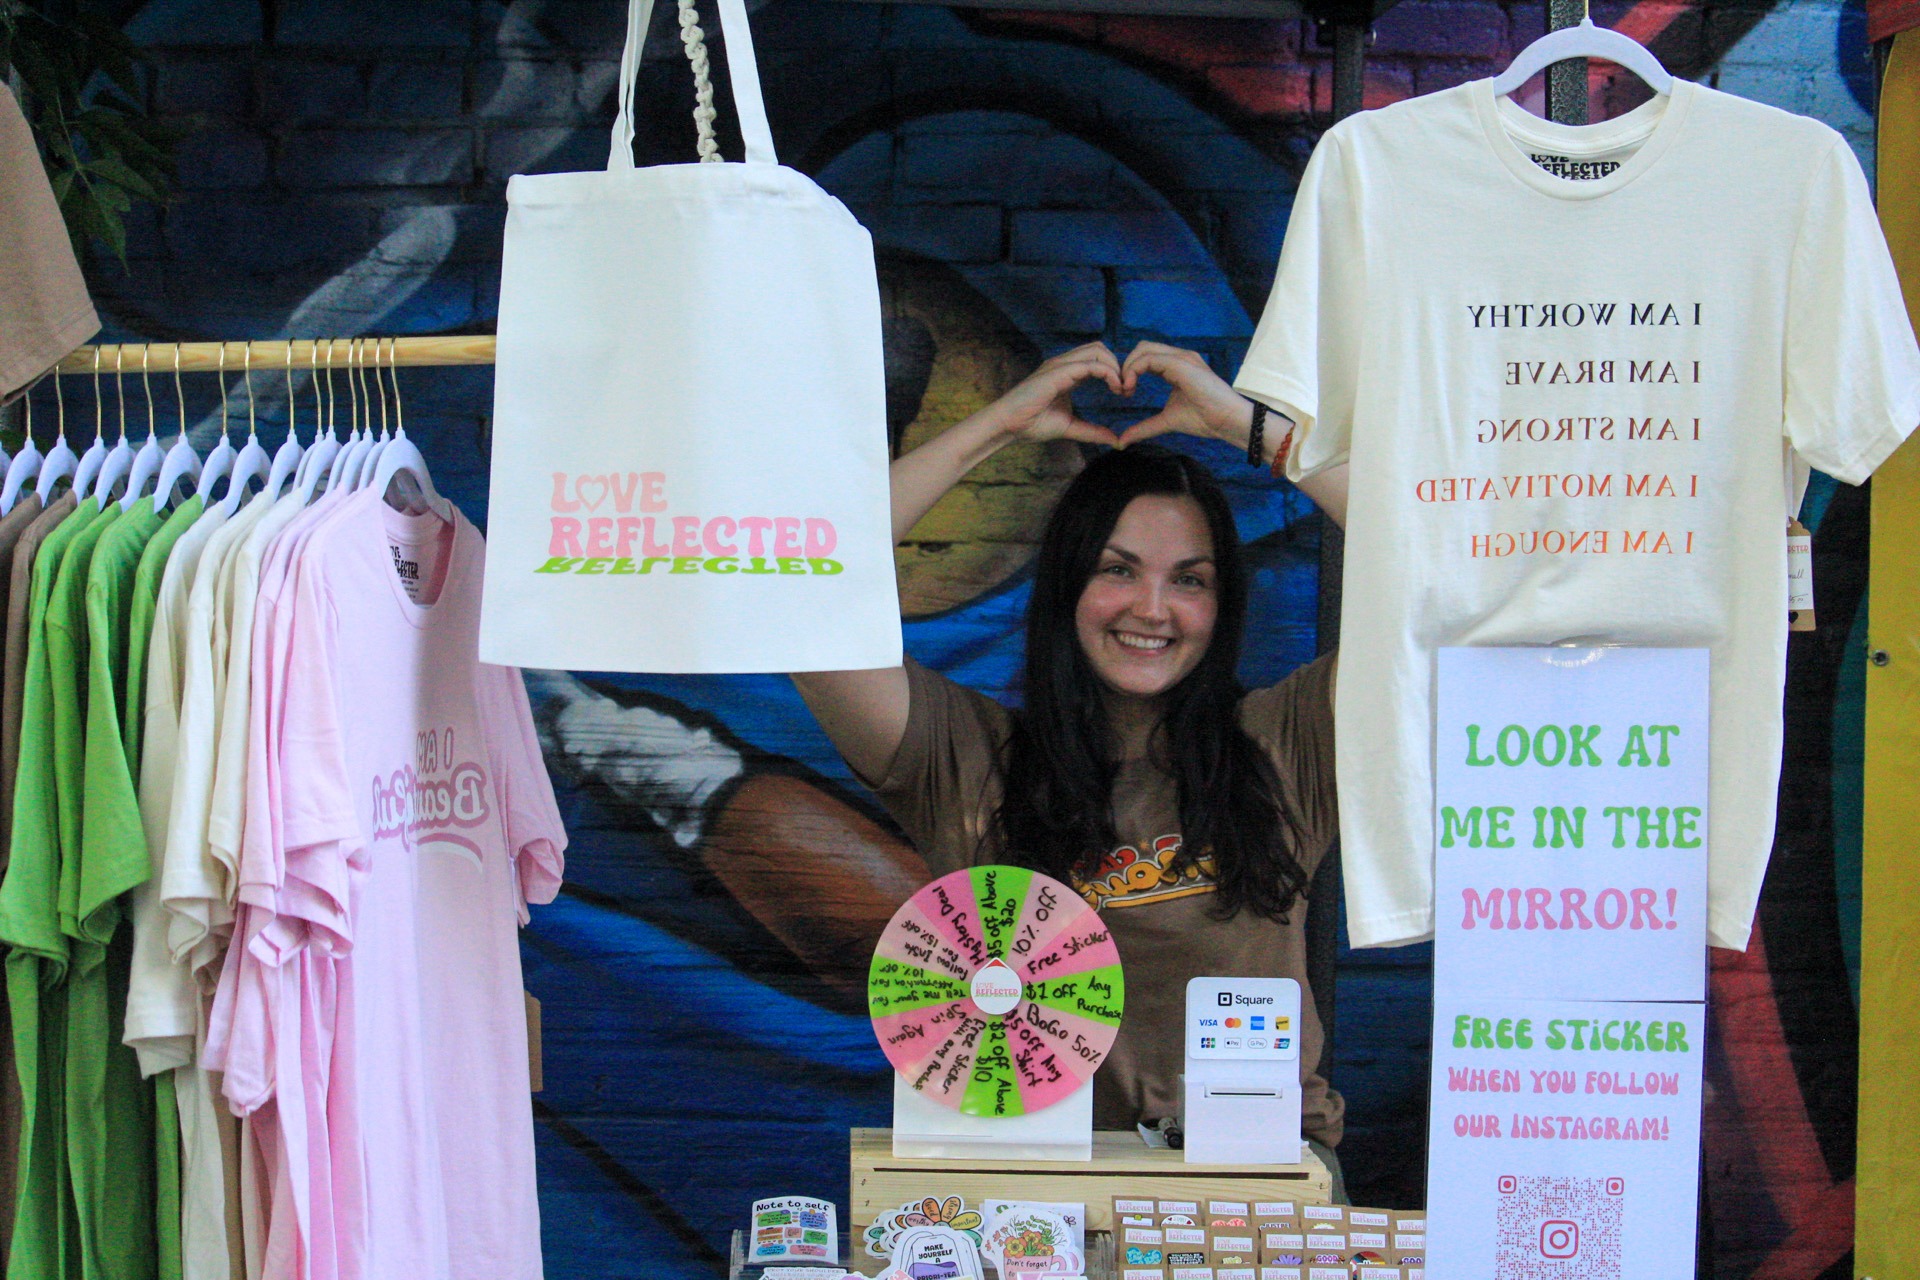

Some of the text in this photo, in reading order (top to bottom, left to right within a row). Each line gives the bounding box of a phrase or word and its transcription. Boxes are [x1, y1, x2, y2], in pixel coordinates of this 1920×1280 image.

[1536, 161, 1621, 177] EFLECTED
[551, 471, 668, 513] LOVE
[548, 515, 838, 558] REFLECTED
[1465, 724, 1680, 767] LOOK AT
[1440, 805, 1702, 849] ME IN THE
[932, 886, 955, 916] Deal
[980, 870, 997, 910] Above
[1000, 898, 1017, 927] $20
[1461, 887, 1678, 931] MIRROR!
[1012, 924, 1040, 957] 10%
[1027, 930, 1109, 975] Free Sticker
[923, 990, 940, 999] me
[945, 989, 966, 998] Tell
[1026, 981, 1048, 1000] $1
[1087, 975, 1112, 999] Any
[1235, 994, 1274, 1006] Square
[887, 1003, 966, 1048] Spin Again
[989, 1022, 1009, 1042] $2
[1452, 1015, 1534, 1050] FREE
[1072, 1034, 1101, 1063] 50%
[942, 1054, 970, 1095] Sticker
[974, 1055, 993, 1082] $10
[1015, 1049, 1043, 1087] Shirt
[1040, 1054, 1062, 1082] Any
[1447, 1066, 1680, 1095] WHEN YOU FOLLOW
[995, 1077, 1012, 1116] Above
[1453, 1113, 1669, 1141] OUR INSTAGRAM!
[756, 1200, 830, 1212] Note to self
[918, 1249, 953, 1259] YOURSELF
[924, 1243, 944, 1252] MAKE
[1006, 1259, 1048, 1269] Don't forget
